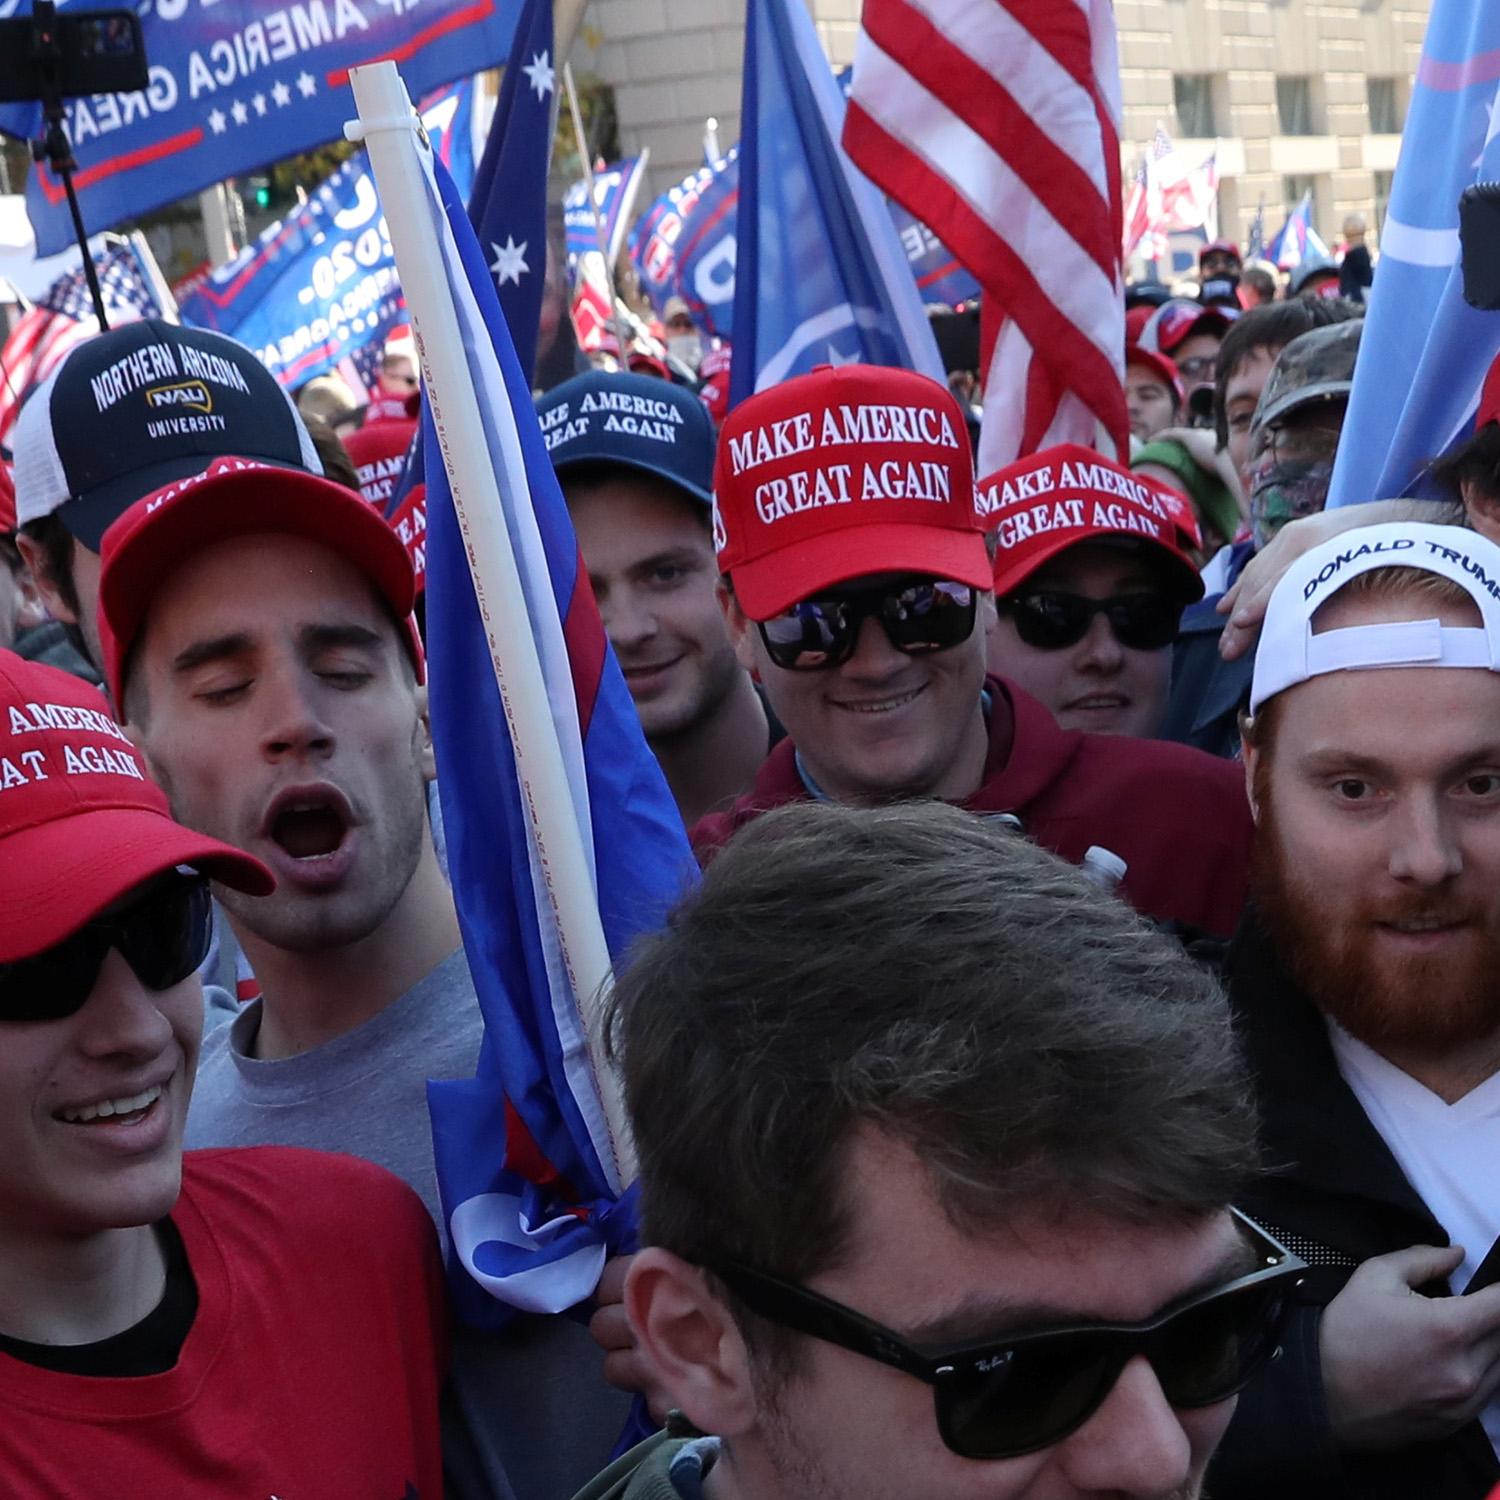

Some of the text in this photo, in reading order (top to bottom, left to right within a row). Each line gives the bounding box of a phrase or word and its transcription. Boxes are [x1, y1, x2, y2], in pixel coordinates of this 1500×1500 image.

[90, 342, 250, 413] NORTHERN ARIZONA
[152, 387, 205, 407] NAU
[147, 414, 226, 438] UNIVERSITY
[538, 402, 570, 432] AKE
[580, 391, 684, 424] AMERICA
[543, 414, 676, 451] REAT AGAIN
[728, 405, 959, 476] MAKE AMERICA
[754, 463, 852, 525] GREAT
[861, 461, 950, 503] AGAIN
[977, 465, 1055, 516] MAKE
[1059, 461, 1168, 520] AMERICA
[1000, 500, 1085, 549] GREAT
[1091, 501, 1160, 537] AGAIN
[1303, 539, 1416, 601] DONALD
[63, 745, 145, 781] AGAIN
